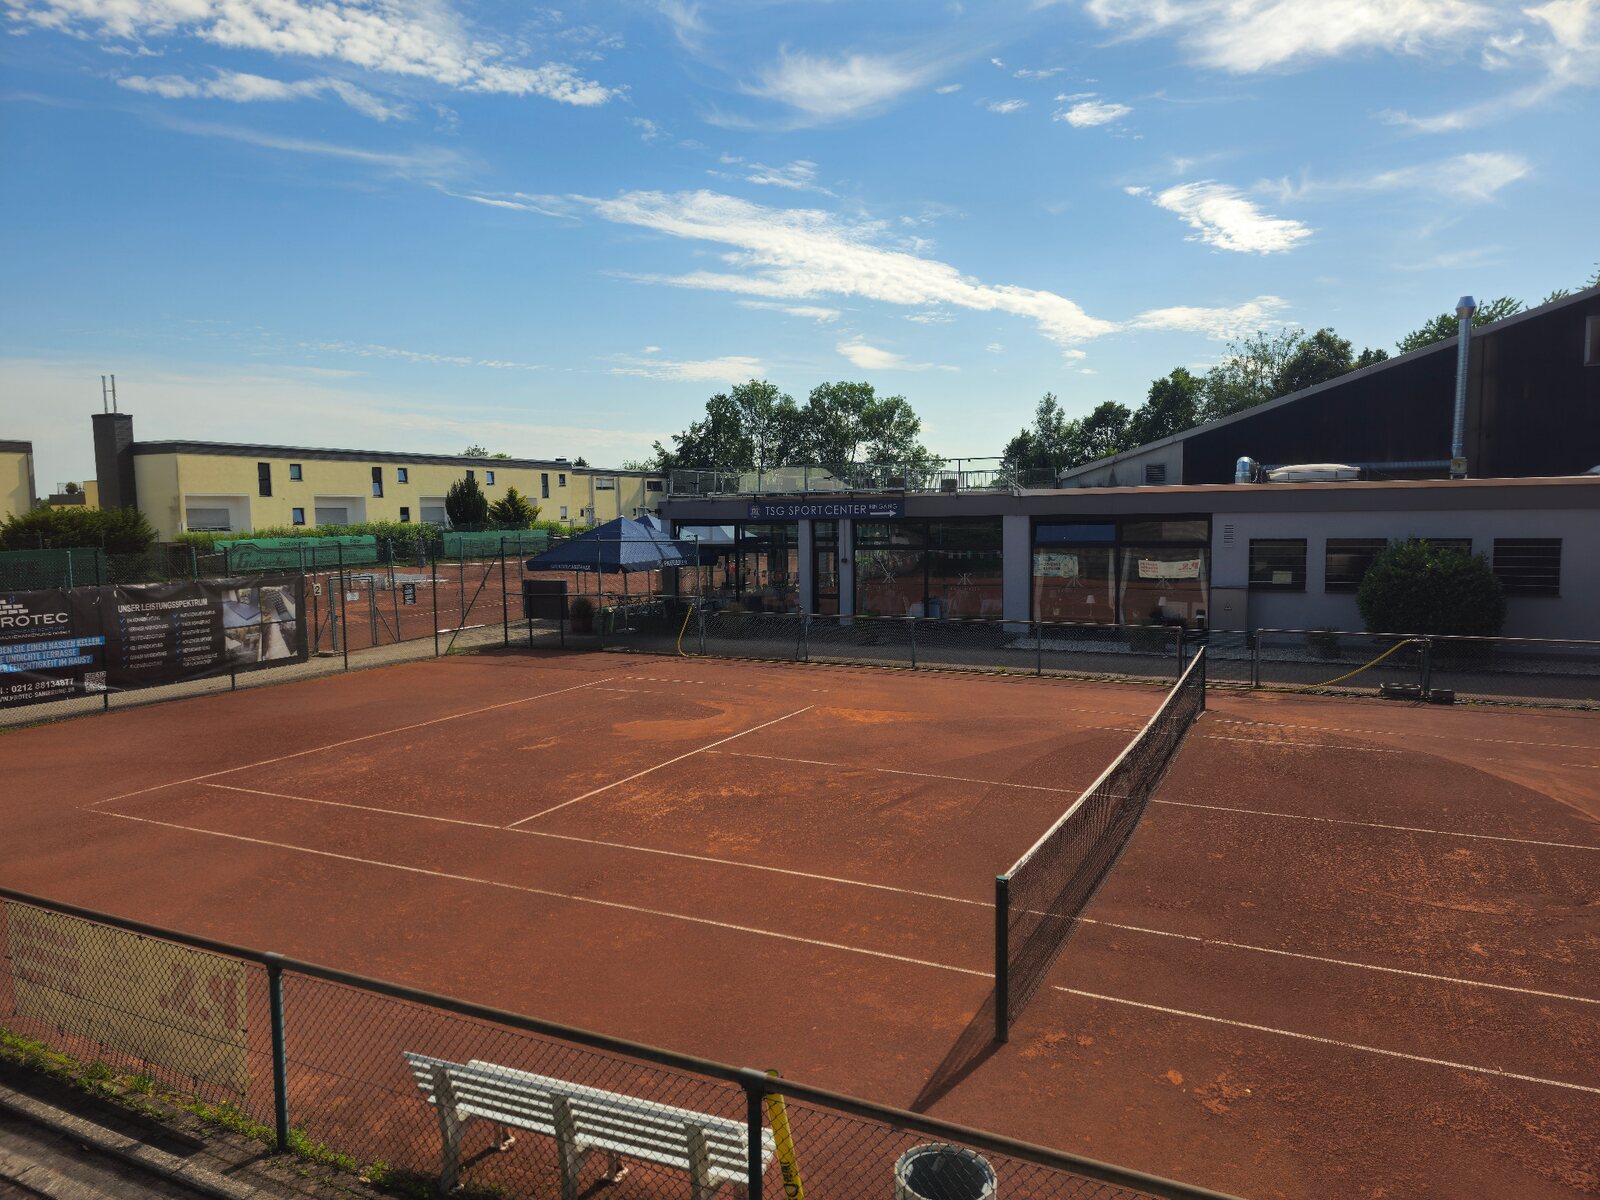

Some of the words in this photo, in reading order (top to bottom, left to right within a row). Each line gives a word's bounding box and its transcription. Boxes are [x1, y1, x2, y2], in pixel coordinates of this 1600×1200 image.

[765, 506, 785, 516] TSG
[788, 505, 823, 516] SPORT
[824, 504, 867, 515] CENTER
[118, 603, 141, 613] UNSER
[141, 598, 208, 611] LEISTUNGSSPEKTRUM
[13, 644, 26, 653] SIE
[26, 642, 48, 652] EINEN
[48, 640, 76, 650] NASSEN
[5, 652, 41, 663] UNDICHTE
[42, 649, 77, 659] TERRASSE
[9, 659, 57, 671] FEUCHTIGKEIT
[58, 658, 67, 666] IM
[68, 655, 91, 665] HAUS?
[11, 684, 33, 693] 0212
[35, 678, 74, 690] 88134877
